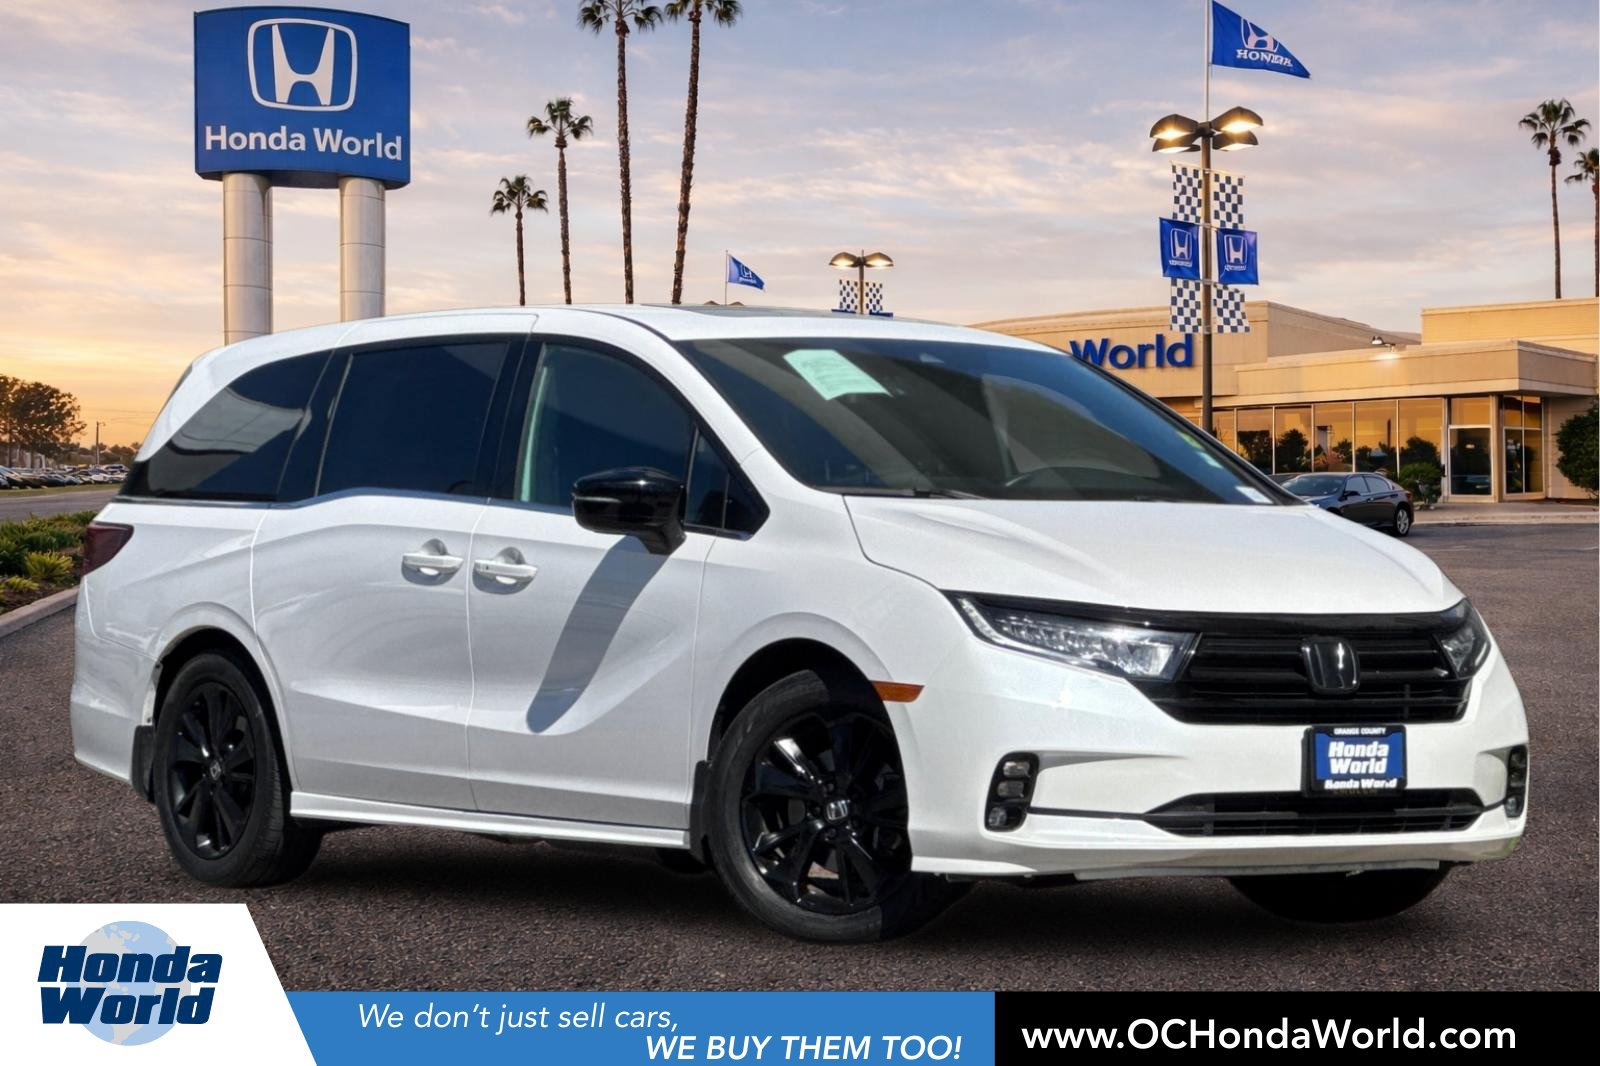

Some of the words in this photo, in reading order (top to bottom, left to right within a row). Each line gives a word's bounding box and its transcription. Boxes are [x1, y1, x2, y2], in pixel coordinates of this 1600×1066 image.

[205, 125, 306, 151] Honda
[313, 127, 403, 161] World
[1069, 333, 1194, 369] World
[1328, 741, 1389, 758] Honda
[1330, 758, 1388, 774] World
